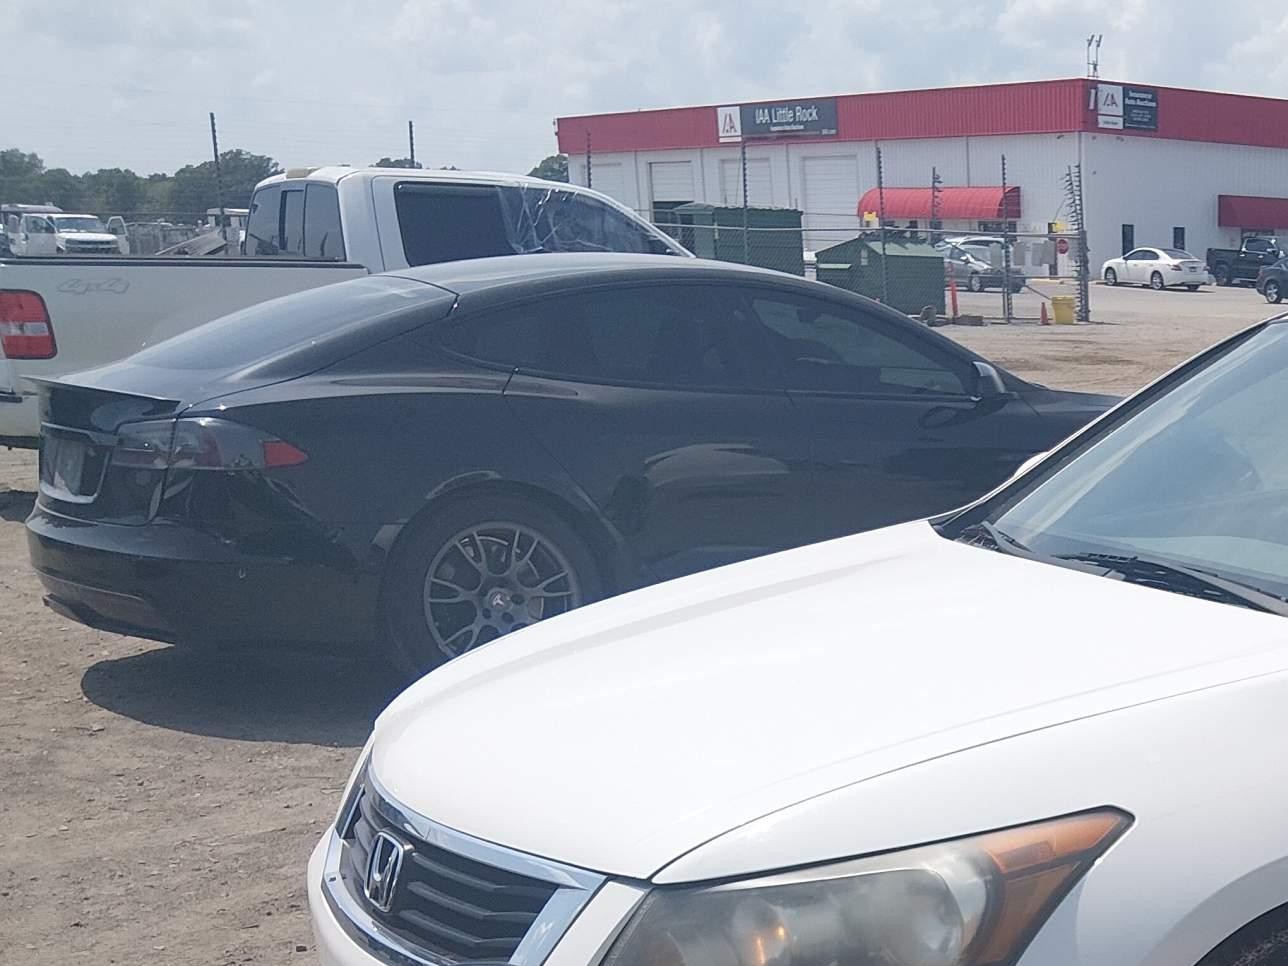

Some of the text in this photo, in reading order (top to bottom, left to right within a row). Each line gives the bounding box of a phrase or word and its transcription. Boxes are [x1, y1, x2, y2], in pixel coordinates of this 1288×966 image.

[755, 105, 819, 124] IAA Little Rock
